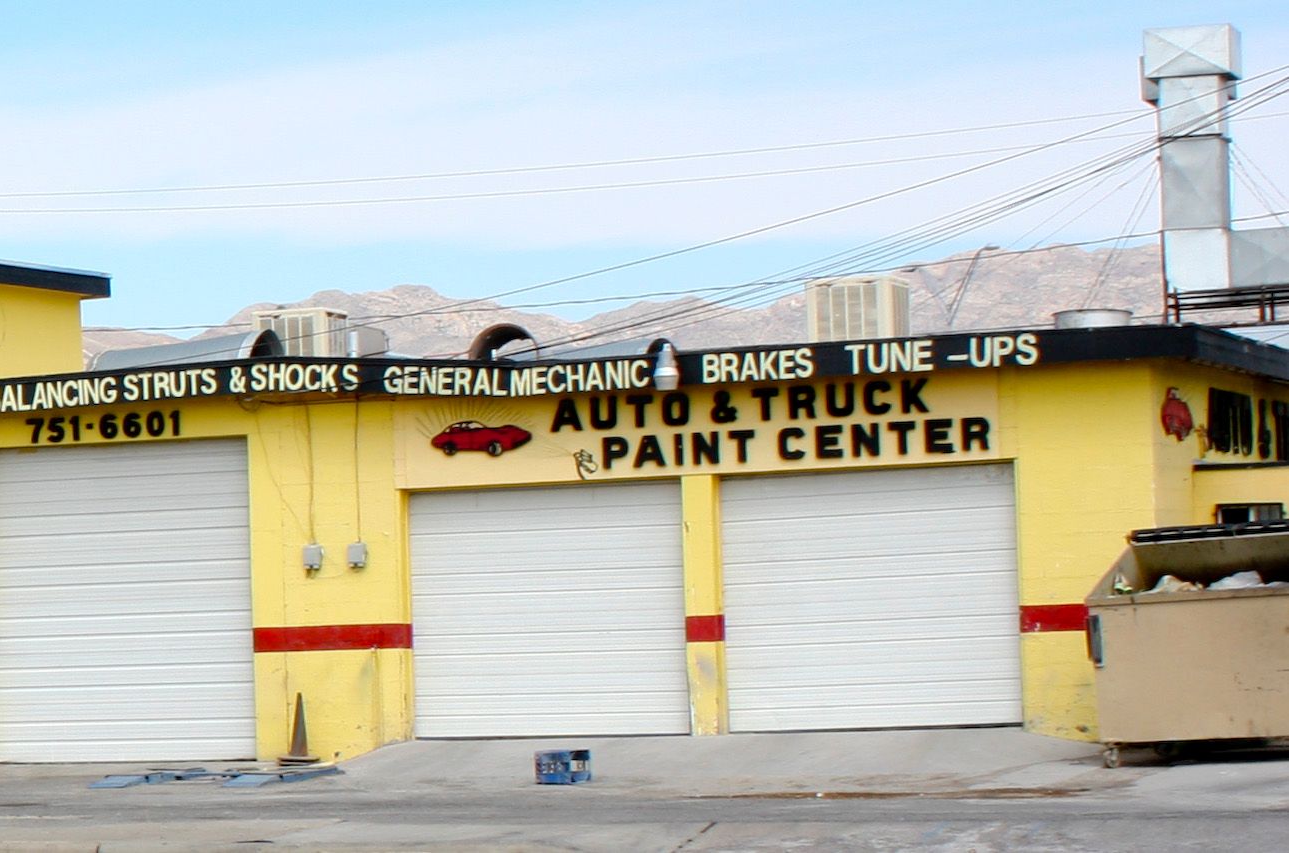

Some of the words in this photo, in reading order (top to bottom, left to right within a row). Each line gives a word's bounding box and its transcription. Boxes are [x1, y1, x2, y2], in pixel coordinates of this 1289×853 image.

[123, 368, 217, 400] STRUTS
[230, 366, 246, 393] &
[250, 364, 359, 393] SHOCKS
[383, 365, 508, 396] GENERAL
[510, 360, 650, 397] MECHANIC
[702, 348, 814, 384] BRAKES
[844, 340, 934, 375] TUNE
[25, 410, 181, 443] 751-6601
[551, 392, 690, 432] AUTO
[710, 390, 738, 424] &
[752, 378, 930, 421] TRUCK
[602, 430, 754, 469] PAINT
[778, 417, 991, 460] CENTER
